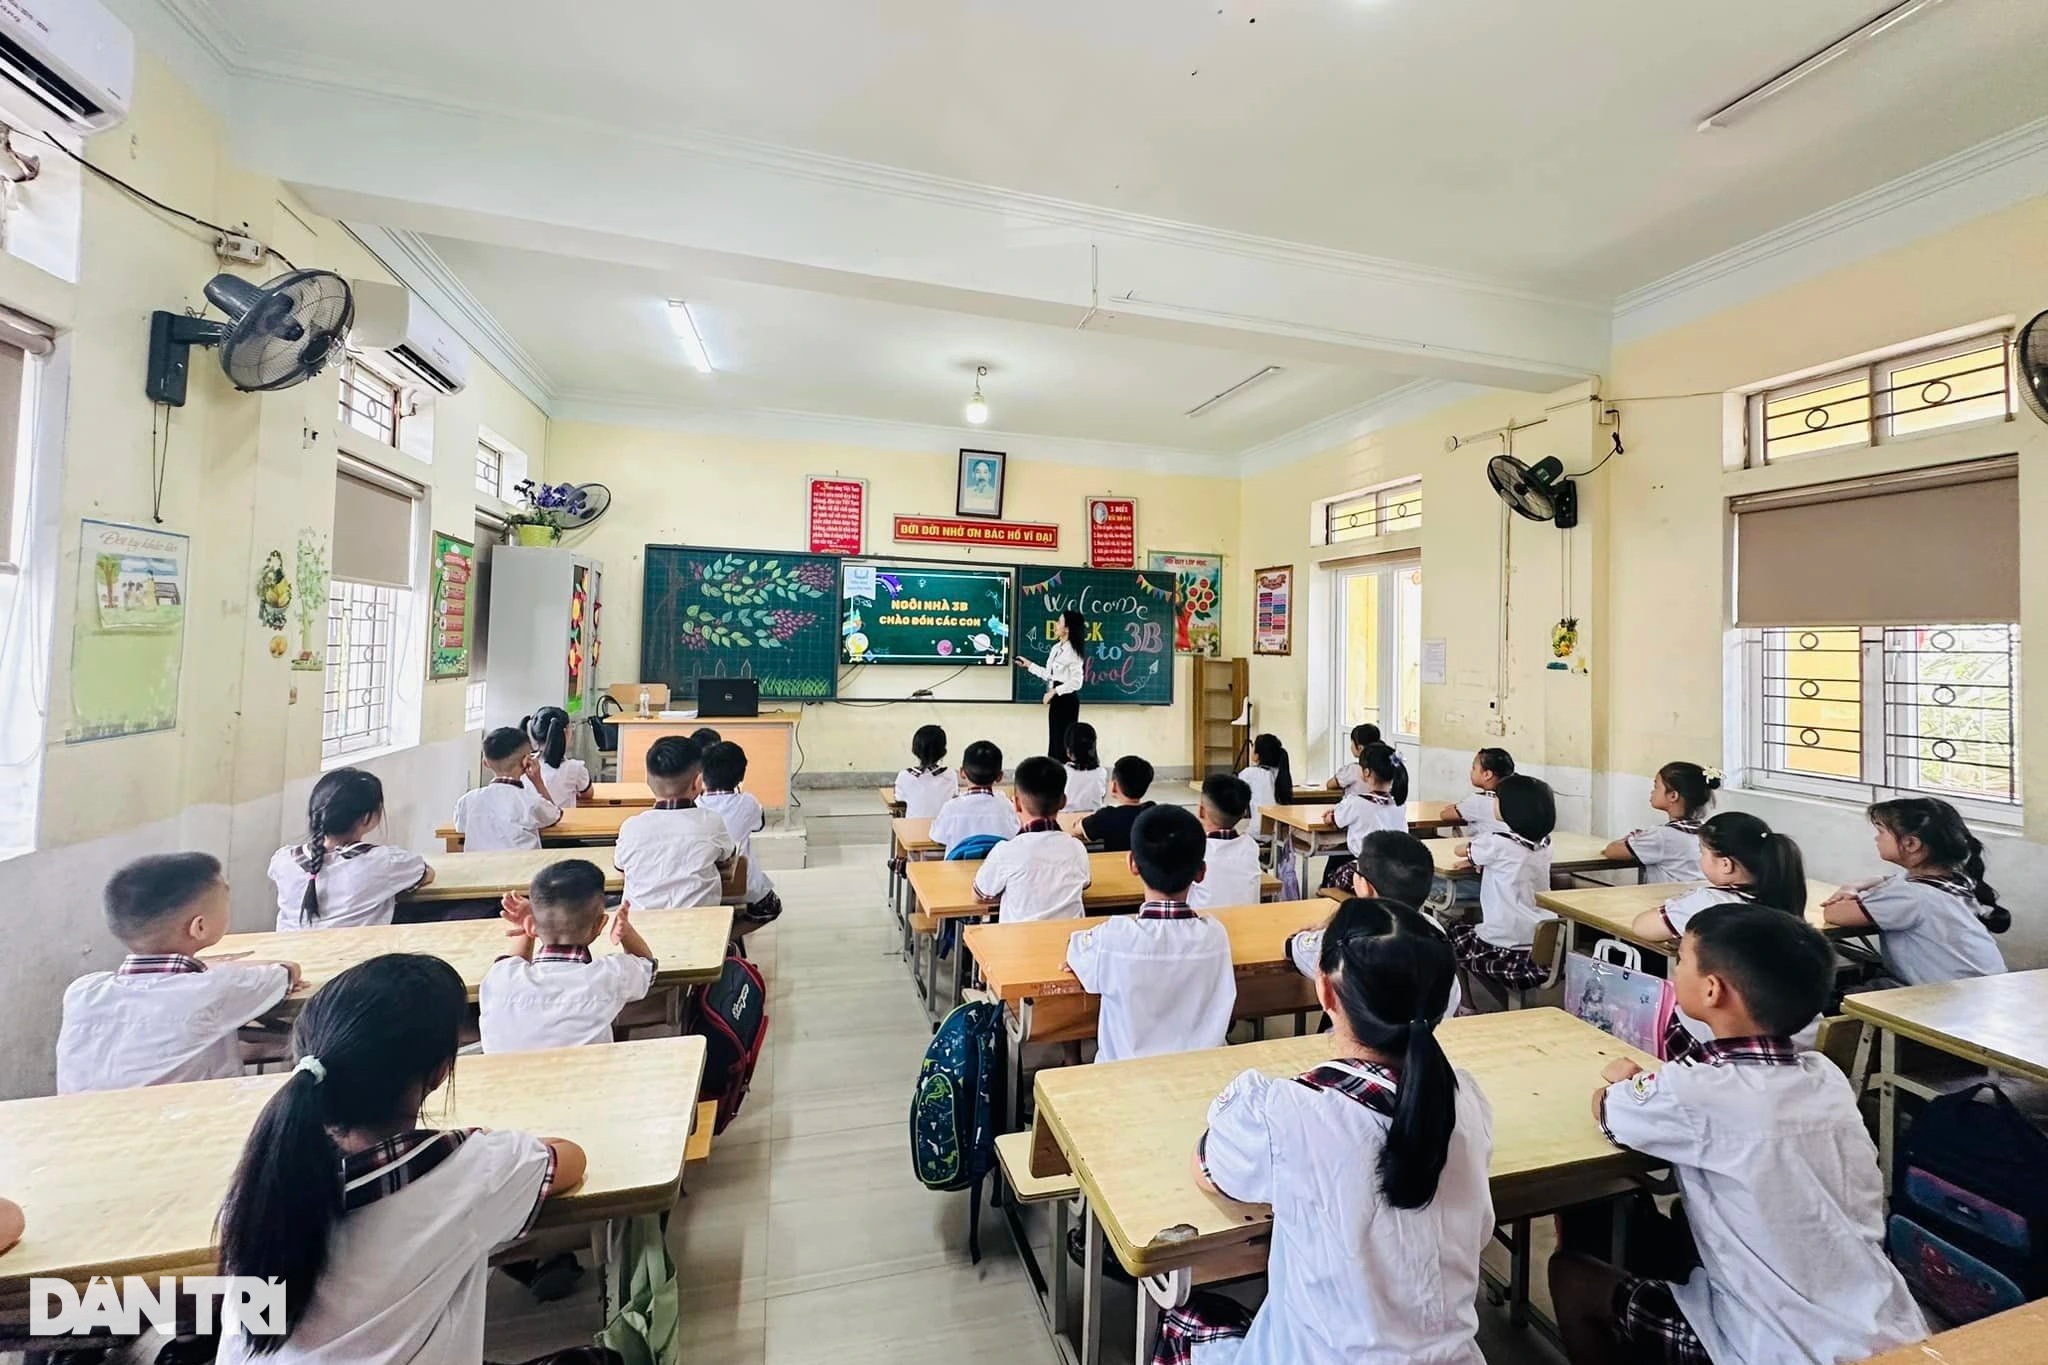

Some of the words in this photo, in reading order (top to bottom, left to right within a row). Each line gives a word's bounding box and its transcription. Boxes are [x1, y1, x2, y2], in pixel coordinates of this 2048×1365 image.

[984, 527, 1005, 539] BÁC
[891, 597, 922, 611] NGÔI
[924, 598, 950, 611] NHÀ
[951, 601, 969, 612] 3B
[879, 613, 910, 625] CHÀO
[911, 614, 934, 626] ĐÓN
[935, 615, 958, 627] CÁC
[959, 617, 981, 627] CON
[1122, 622, 1163, 653] 3B
[1096, 642, 1122, 660] to
